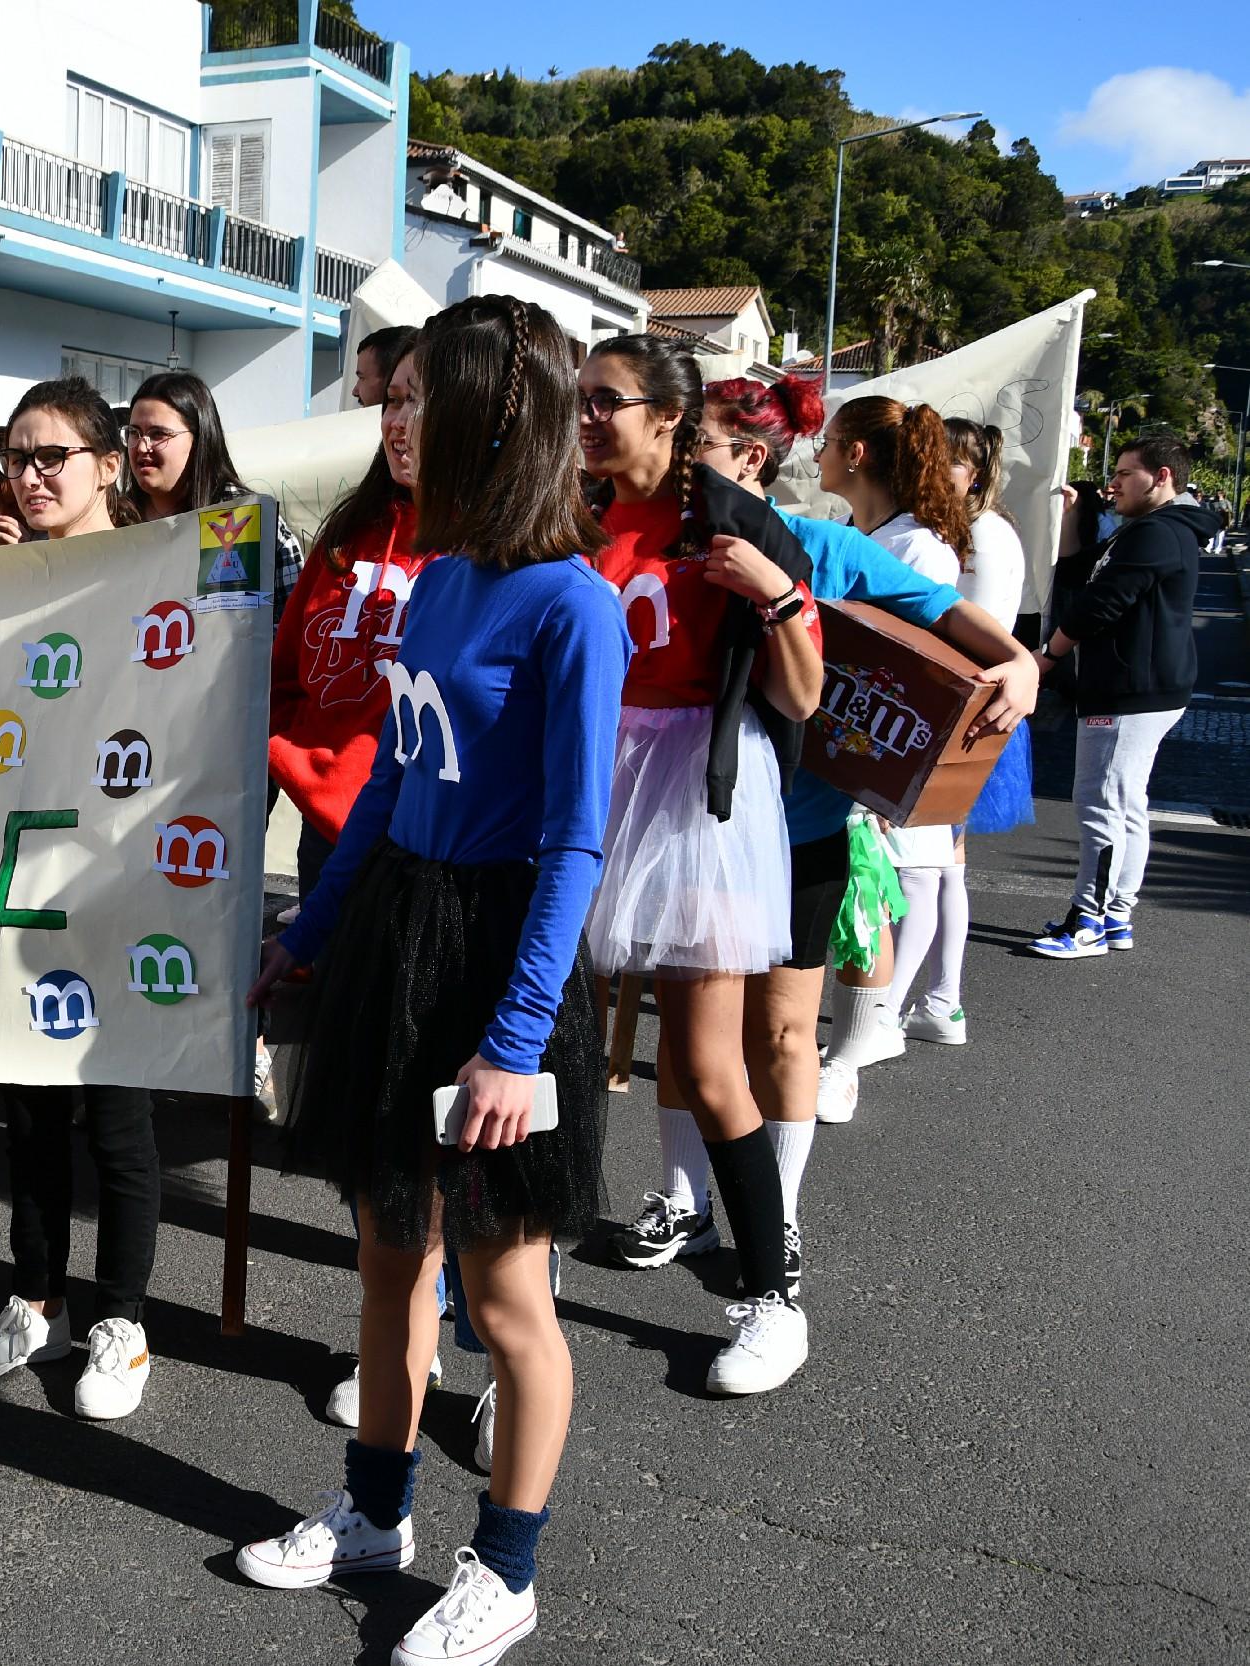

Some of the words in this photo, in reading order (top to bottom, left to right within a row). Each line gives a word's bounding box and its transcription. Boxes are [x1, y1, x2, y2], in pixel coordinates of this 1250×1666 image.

[130, 609, 193, 662] m
[17, 641, 81, 687] m
[92, 736, 153, 786] m
[154, 822, 228, 879] m
[126, 944, 198, 994] m
[25, 979, 100, 1031] m
